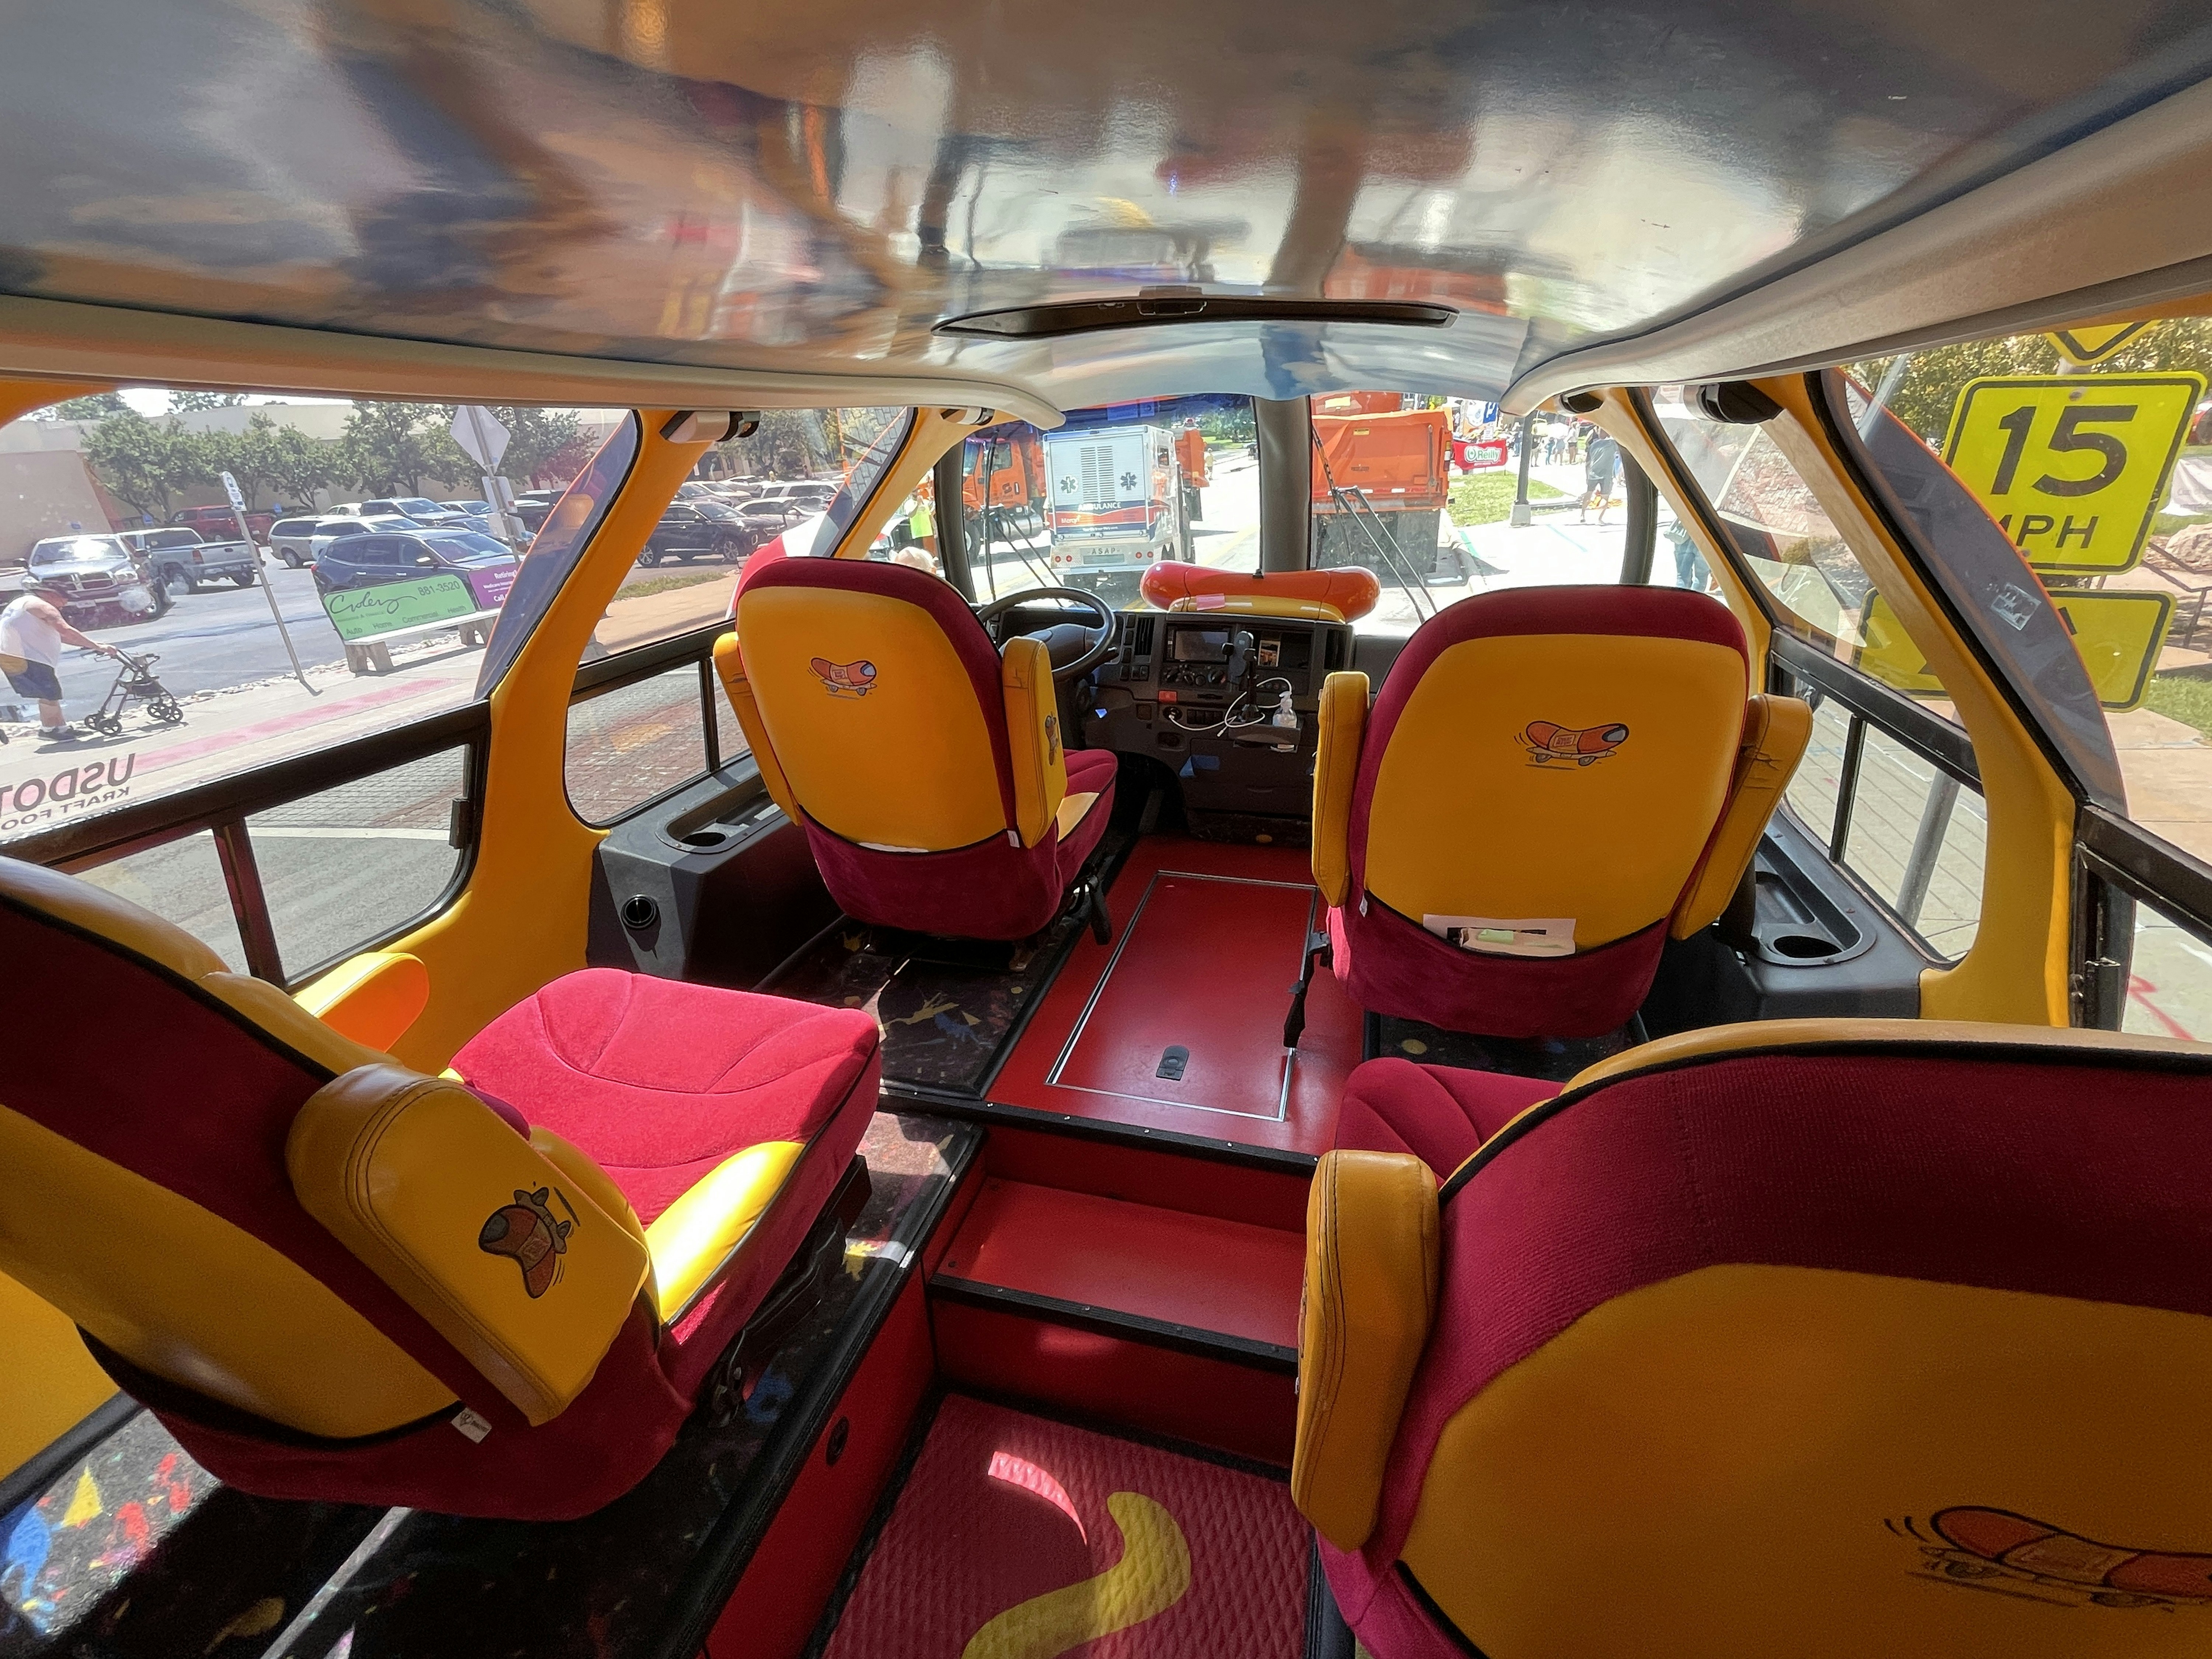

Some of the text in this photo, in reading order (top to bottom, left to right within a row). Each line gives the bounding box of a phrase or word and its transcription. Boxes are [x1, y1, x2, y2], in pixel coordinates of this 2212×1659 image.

[1990, 405, 2138, 497] 15
[1078, 502, 1121, 511] AMBULANCE
[417, 580, 460, 596] 881-3520
[372, 621, 393, 629] Home
[402, 611, 439, 623] Commercial
[447, 605, 467, 614] Health
